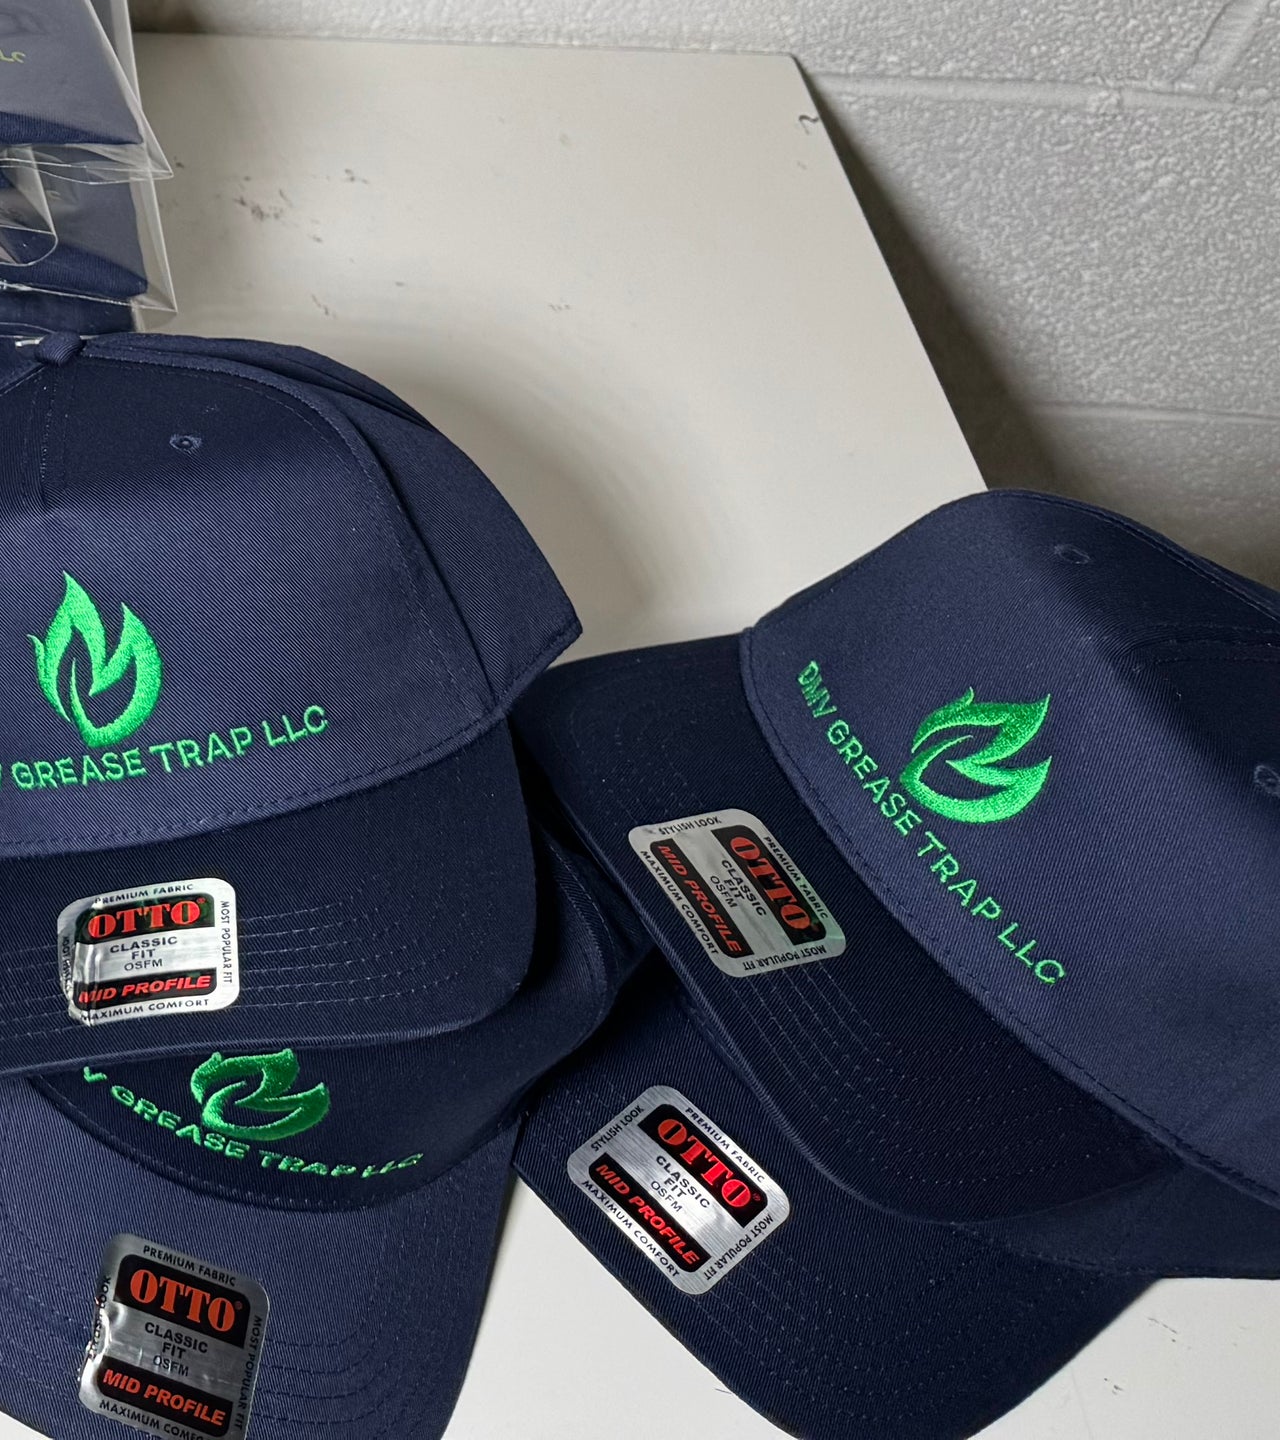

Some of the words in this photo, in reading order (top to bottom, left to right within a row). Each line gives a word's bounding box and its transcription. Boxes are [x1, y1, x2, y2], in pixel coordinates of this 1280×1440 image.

[11, 747, 148, 791] GREASE
[149, 726, 255, 773] TRAP
[261, 704, 330, 747] LLC
[658, 821, 694, 835] STYLISH
[696, 816, 722, 829] LOOK
[797, 660, 837, 718] DMV
[826, 719, 923, 836] GREASE
[917, 830, 1002, 920] TRAP
[997, 922, 1066, 985] LLC
[95, 889, 149, 904] PREMIUM
[153, 884, 194, 895] FABRIC
[710, 875, 738, 908] OSFM
[721, 859, 767, 916] CLASSIC
[723, 879, 745, 900] FIT
[730, 836, 811, 929] OTTO
[763, 836, 801, 882] PREMIUM
[799, 883, 828, 919] FABRIC
[220, 901, 230, 930] MOST
[640, 850, 682, 901] MAXIMUM
[682, 903, 719, 955] COMFORT
[657, 845, 688, 876] MID
[684, 879, 742, 952] PROFILE
[88, 900, 201, 939] OTTO
[109, 936, 178, 954] CLASSIC
[131, 949, 156, 960] FIT
[221, 931, 231, 969] POPULAR
[758, 951, 800, 968] POPULAR
[800, 945, 827, 960] MOST
[124, 958, 163, 972] OSFM
[223, 971, 233, 983] FIT
[742, 961, 756, 971] FIT
[121, 975, 212, 997] PROFILE
[148, 999, 210, 1011] COMFORT
[110, 1085, 251, 1160] GREASE
[258, 1149, 358, 1178] TRAP
[590, 1122, 622, 1152] STYLISH
[621, 1105, 645, 1126] LOOK
[685, 1107, 731, 1150] PREMIUM
[730, 1149, 765, 1184] FABRIC
[657, 1118, 751, 1207] OTTO
[650, 1179, 683, 1213] OSFM
[655, 1155, 711, 1208] CLASSIC
[664, 1177, 688, 1198] FIT
[582, 1180, 633, 1230] MAXIMUM
[633, 1229, 680, 1277] COMFORT
[595, 1164, 631, 1195] MID
[629, 1194, 701, 1264] PROFILE
[751, 1214, 774, 1238] MOST
[143, 1245, 195, 1271] PREMIUM
[198, 1265, 237, 1287] FABRIC
[715, 1235, 752, 1271] POPULAR
[702, 1267, 718, 1281] FIT
[130, 1269, 236, 1332] OTTO
[144, 1322, 209, 1354] CLASSIC
[249, 1315, 263, 1350] MOST
[152, 1355, 189, 1378] OSFM
[162, 1342, 187, 1360] FIT
[103, 1368, 141, 1394] MID
[143, 1385, 226, 1426] PROFILE
[237, 1353, 256, 1409] POPULAR
[99, 1399, 160, 1430] MAXIMUM
[234, 1411, 246, 1430] FIT
